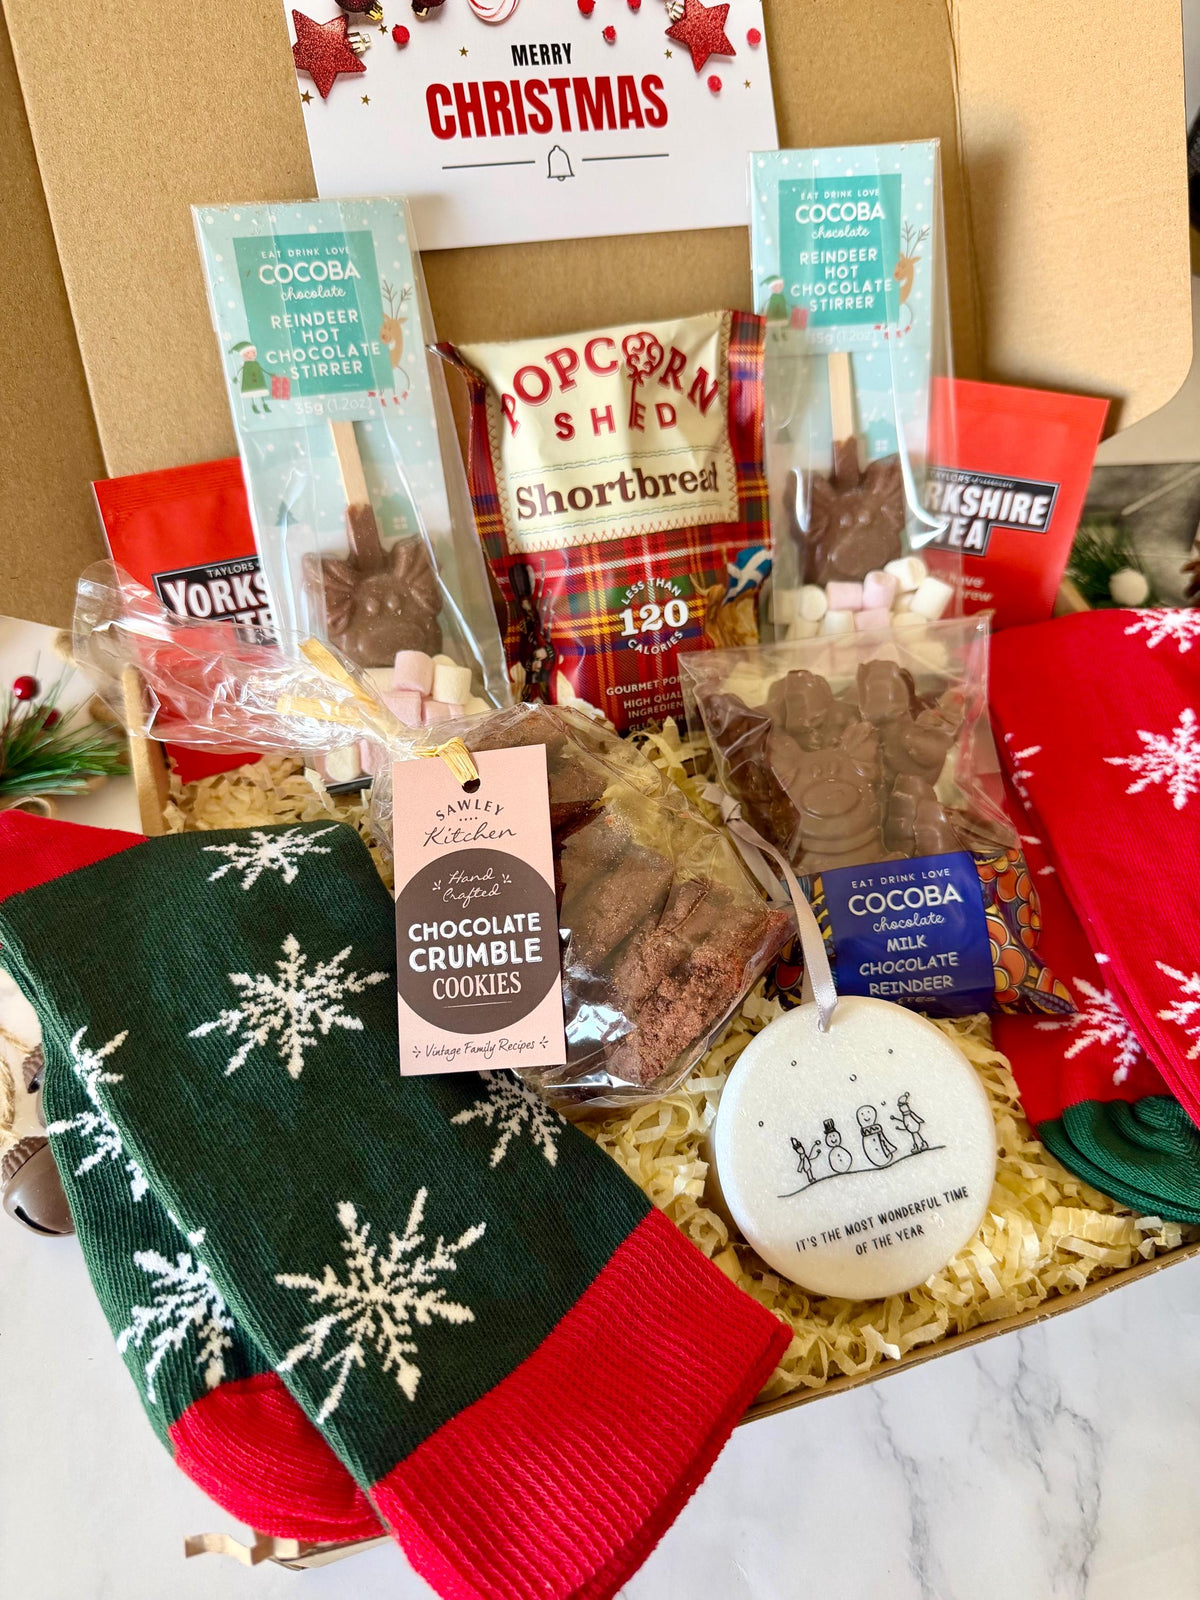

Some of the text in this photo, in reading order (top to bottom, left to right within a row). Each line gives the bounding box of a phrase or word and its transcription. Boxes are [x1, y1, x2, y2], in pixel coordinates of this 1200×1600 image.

[511, 43, 571, 66] MERRY
[426, 74, 668, 140] CHRISTMAS
[801, 188, 880, 200] EAT DRINK LOVE
[795, 202, 886, 224] COCOBA
[811, 225, 871, 241] chocolate
[261, 246, 350, 259] EAT DRINK LOVE
[800, 248, 877, 265] REINDEER
[258, 260, 361, 284] COCOBA
[825, 265, 858, 279] HOT
[280, 285, 346, 301] chocolate
[790, 279, 893, 297] CHOCOLATE
[809, 295, 874, 312] STIRRER
[270, 309, 359, 330] REINDEER
[302, 328, 339, 344] HOT
[266, 342, 381, 364] CHOCOLATE
[290, 360, 363, 380] STIRRER
[501, 331, 719, 437] POPCORN
[294, 401, 324, 415] 35g
[554, 402, 677, 441] SHED
[515, 461, 719, 521] Shortbread
[924, 481, 1051, 526] RKSHIRE
[934, 514, 986, 549] TEA
[206, 562, 255, 578] TAYLORS
[161, 570, 270, 618] YORKS
[621, 577, 682, 605] LESS THAN
[236, 609, 278, 644] TE
[619, 599, 689, 637] 120
[627, 631, 684, 655] CALORIES
[606, 674, 691, 696] GOURMET POPC
[623, 690, 683, 709] HIGH QUAL
[628, 701, 684, 719] INGREDIEN
[435, 799, 504, 821] SAWLEY
[423, 822, 517, 847] Kitchen
[448, 867, 495, 885] Hand
[851, 868, 950, 889] EAT DRINK LOVE
[442, 884, 502, 908] Crafted
[848, 883, 963, 916] COCOBA
[408, 912, 542, 942] CHOCOLATE
[872, 912, 945, 933] chocolate
[886, 934, 928, 953] MILK
[408, 937, 543, 973] CRUMBLE
[859, 952, 960, 977] CHOCOLATE
[432, 971, 522, 1000] COOKIES
[869, 975, 954, 996] REINDEER
[424, 1038, 535, 1062] Vintage Family Recipes
[796, 1186, 969, 1253] IT'S THE MOST WONDERFUL TIME
[855, 1224, 925, 1256] OF THE YEAR
